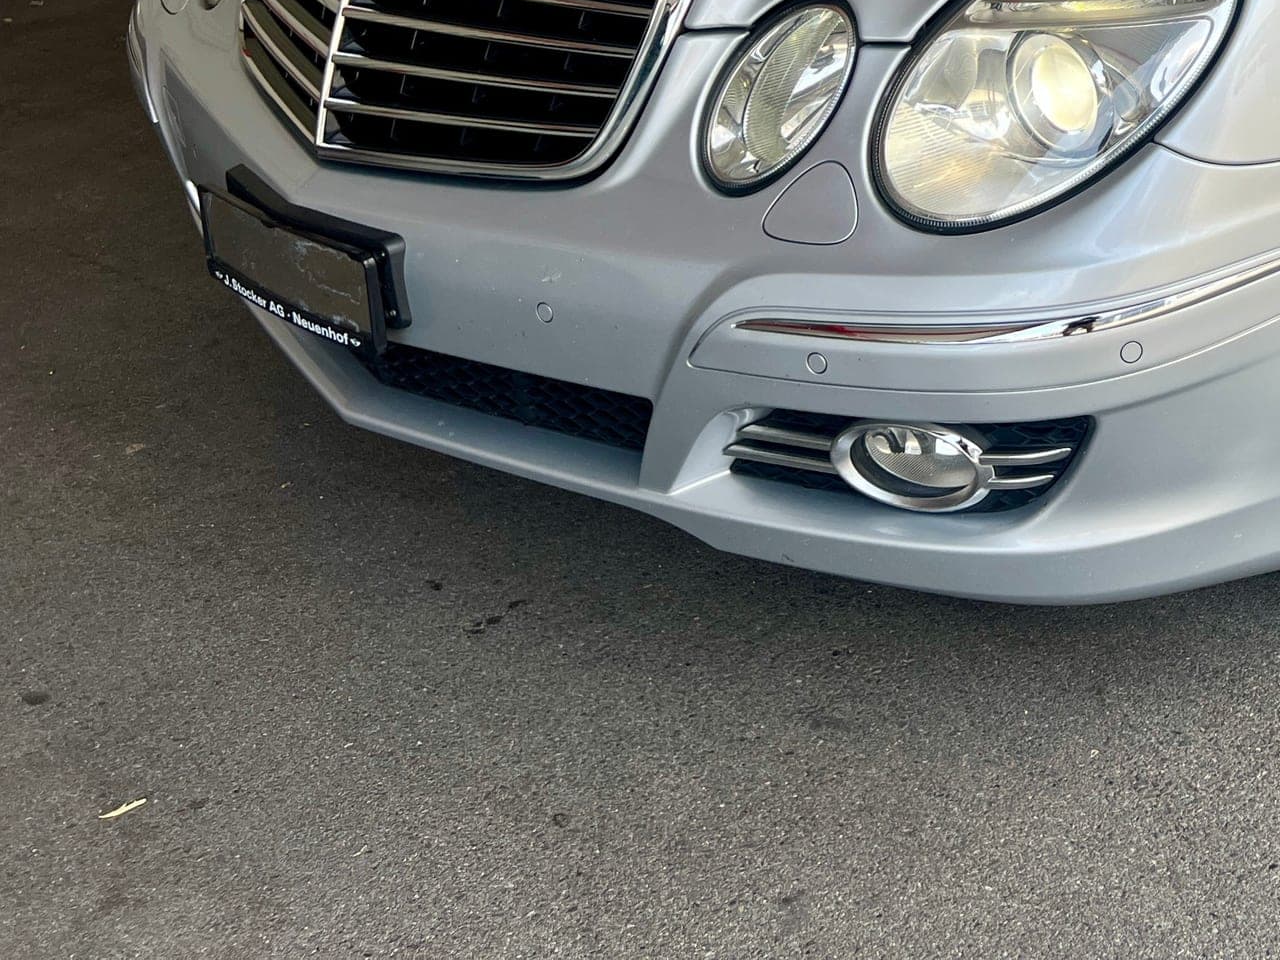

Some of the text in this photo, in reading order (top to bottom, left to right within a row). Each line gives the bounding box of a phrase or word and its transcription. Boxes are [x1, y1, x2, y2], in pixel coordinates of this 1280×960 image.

[223, 274, 349, 345] J.Stocker AG Neuenhof
